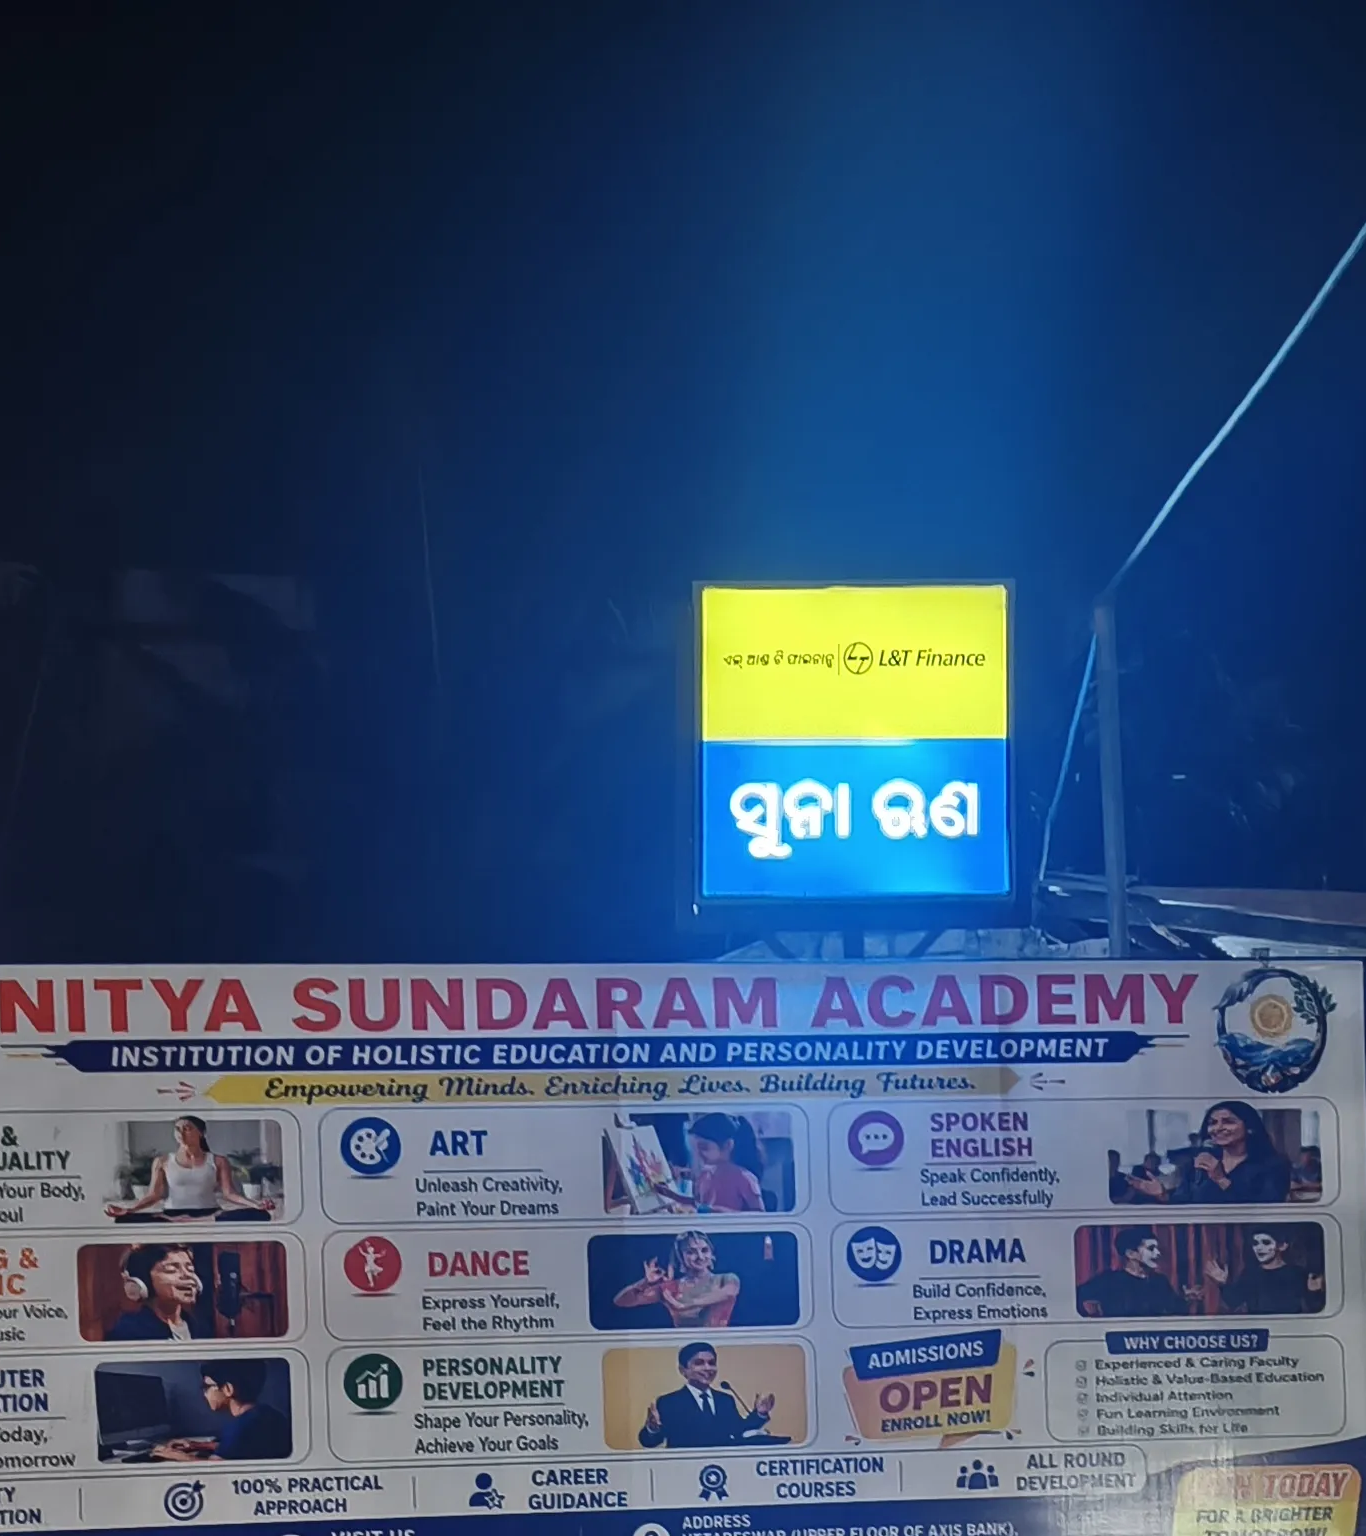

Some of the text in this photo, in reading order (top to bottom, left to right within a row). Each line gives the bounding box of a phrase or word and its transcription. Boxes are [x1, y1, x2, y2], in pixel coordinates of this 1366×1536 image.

[878, 648, 986, 667] L&T Finance
[729, 777, 851, 860] ସୁନା
[291, 976, 780, 1033] SUNDARAM
[810, 972, 1201, 1030] ACADEMY
[111, 1036, 1110, 1068] INSTITUTION OF HOLISTIC EDUCATION AND PERSONALITY DEVELOPMENT
[264, 1070, 976, 1104] Empowering Minds. Enriching Lives. Building Futures.
[930, 1111, 1029, 1132] SPOKEN
[0, 1126, 19, 1148] &
[429, 1129, 488, 1157] ART
[931, 1137, 1034, 1158] ENGLISH
[415, 1176, 563, 1195] Unleash Creativity,
[920, 1166, 1060, 1187] Speak Confidently,
[40, 1181, 85, 1203] Body,
[921, 1189, 1053, 1209] Lead Successfully
[416, 1199, 559, 1217] Paint Your Dreams
[19, 1247, 40, 1270] &
[929, 1237, 1027, 1264] DRAMA
[427, 1250, 530, 1277] DANCE
[913, 1282, 1047, 1300] Build Confidence,
[23, 1304, 68, 1321] Voice,
[422, 1293, 560, 1313] Express Yourself,
[913, 1303, 1048, 1324] Express Emotions
[422, 1314, 554, 1333] Feel the Rhythm
[1123, 1333, 1259, 1351] WHY CHOOSE US?
[868, 1340, 984, 1370] ADMISSIONS
[1095, 1356, 1300, 1372] Experienced & Caring Faculty
[422, 1355, 562, 1377] PERSONALITY
[1095, 1371, 1325, 1386] Holistic & Value-Based Education
[422, 1379, 565, 1402] DEVELOPMENT
[879, 1373, 993, 1414] OPEN
[1096, 1390, 1233, 1403] Individual Attention
[414, 1410, 589, 1432] Shape Your Personality,
[881, 1409, 992, 1433] ENROLL NOW!
[1096, 1404, 1280, 1420] Fun Learning Environment
[1097, 1421, 1249, 1437] Building Skills for Life
[415, 1435, 559, 1455] Achieve Your Goals
[756, 1456, 885, 1478] CERTIFICATION
[1026, 1450, 1127, 1470] ALL ROUND
[231, 1474, 384, 1496] 100% PRACTICAL
[531, 1467, 609, 1487] CAREER
[1016, 1471, 1137, 1492] DEVELOPMENT
[1263, 1470, 1350, 1499] TODAY
[776, 1480, 857, 1500] COURSES
[253, 1497, 348, 1516] APPROACH
[528, 1491, 628, 1511] GUIDANCE
[682, 1514, 751, 1530] ADDRESS
[1196, 1505, 1334, 1524] FOR A BRIGHTER
